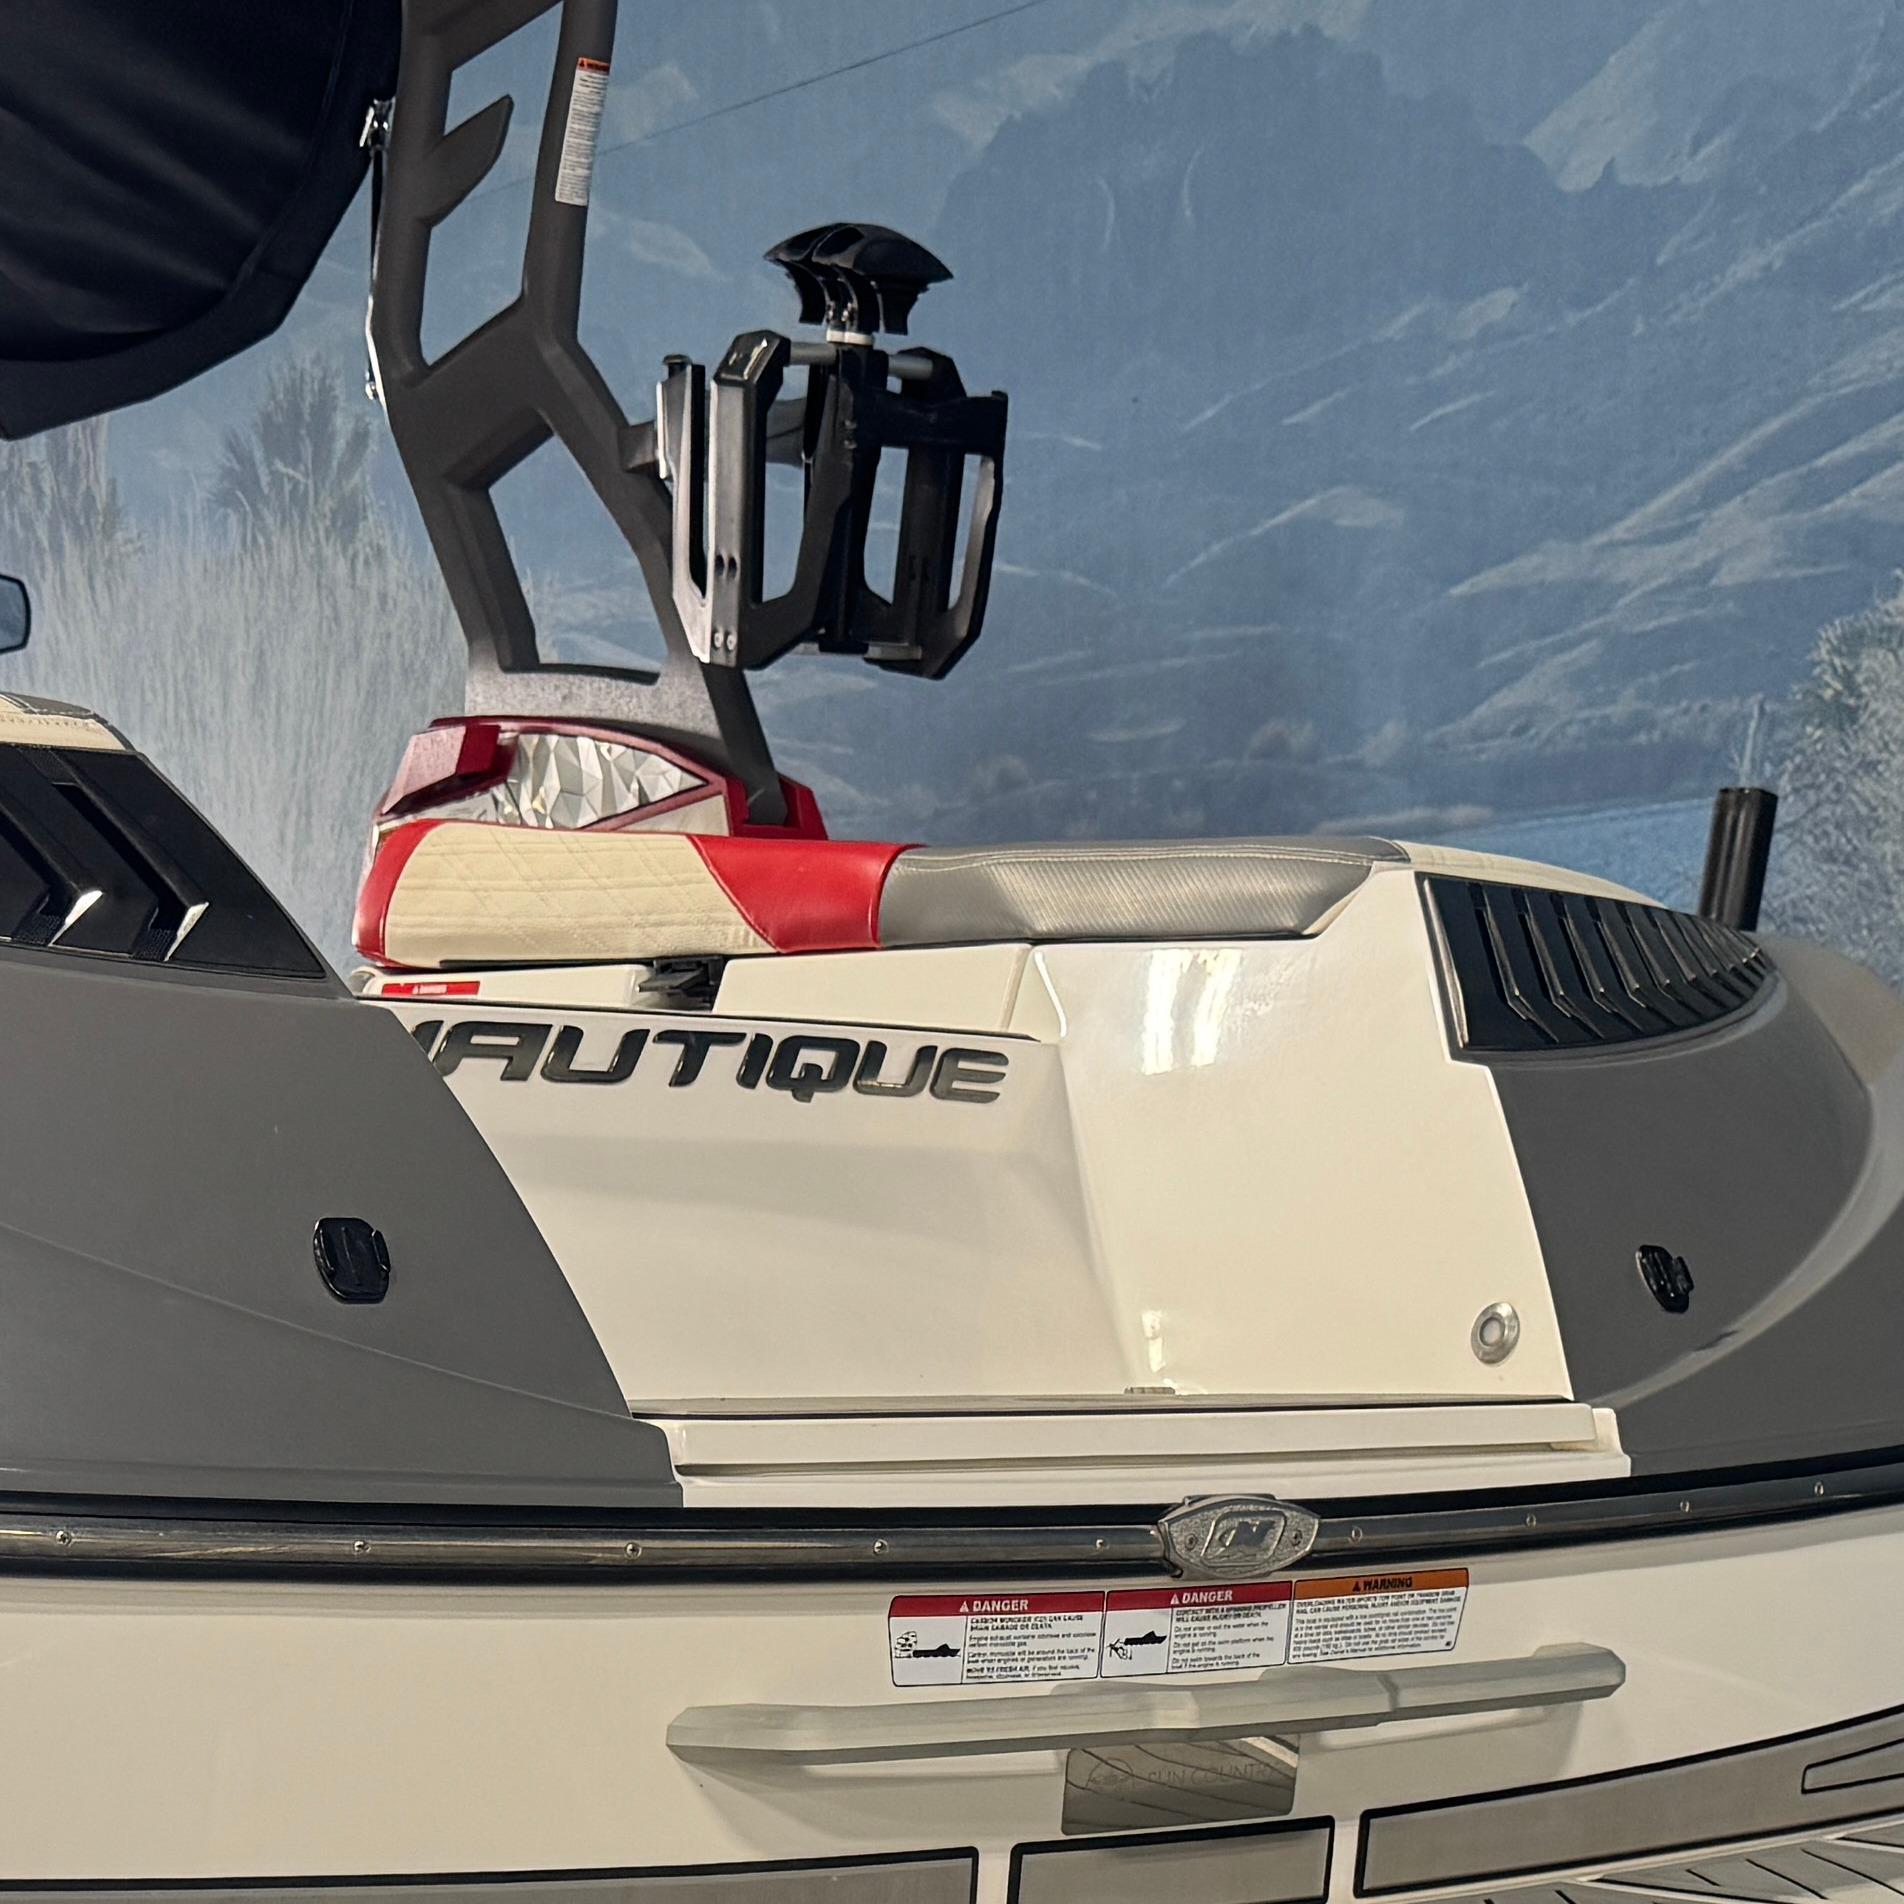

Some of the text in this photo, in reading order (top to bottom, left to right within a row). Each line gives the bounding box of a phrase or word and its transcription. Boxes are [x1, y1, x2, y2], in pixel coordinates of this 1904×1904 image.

[1363, 1577, 1413, 1592] WARNING
[1181, 1590, 1233, 1604] DANGER
[972, 1600, 1029, 1612] DANGER
